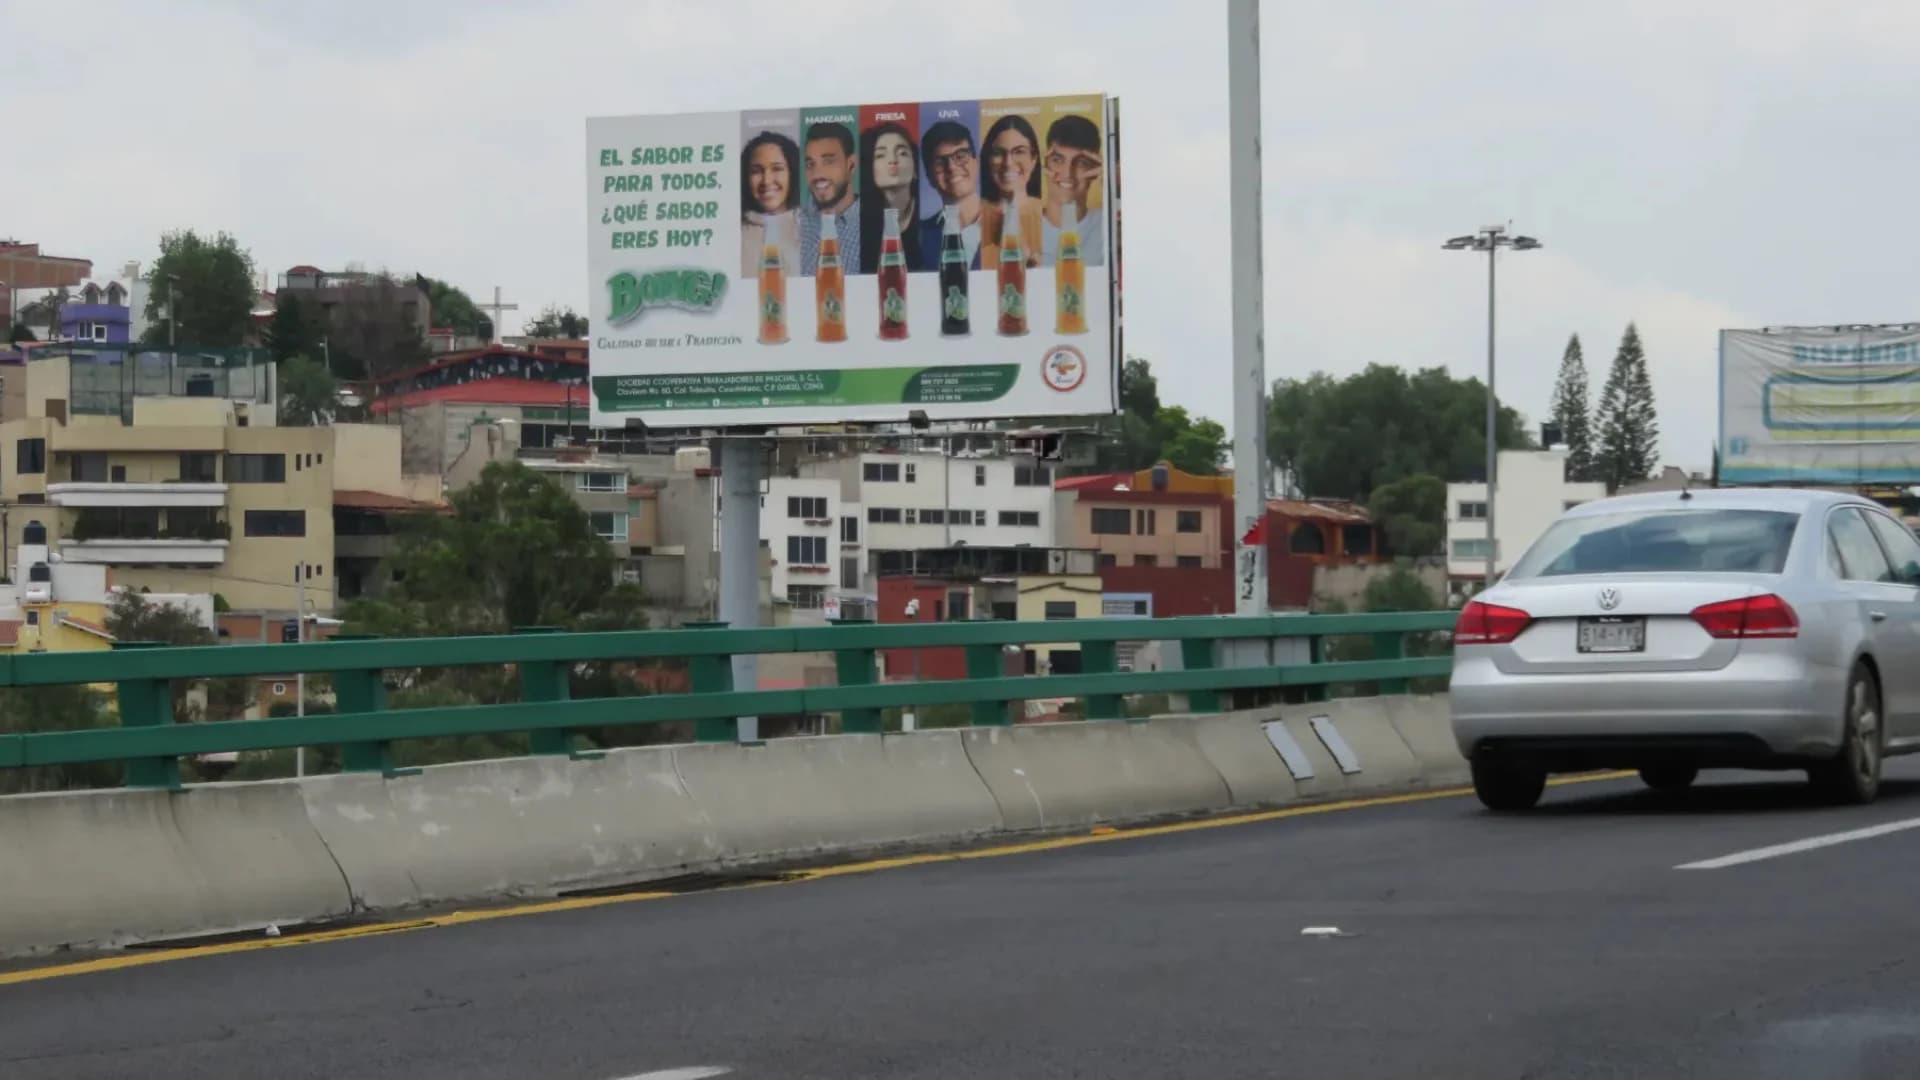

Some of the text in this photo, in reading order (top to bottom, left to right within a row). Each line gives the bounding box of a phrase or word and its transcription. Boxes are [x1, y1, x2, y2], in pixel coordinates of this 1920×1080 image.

[875, 112, 906, 121] FRESA
[938, 109, 960, 118] UVA
[600, 144, 725, 166] EL SABOR ES
[604, 175, 653, 193] PARA
[602, 200, 718, 224] ¿QUÉ SABOR
[611, 228, 713, 249] ERES HOY?
